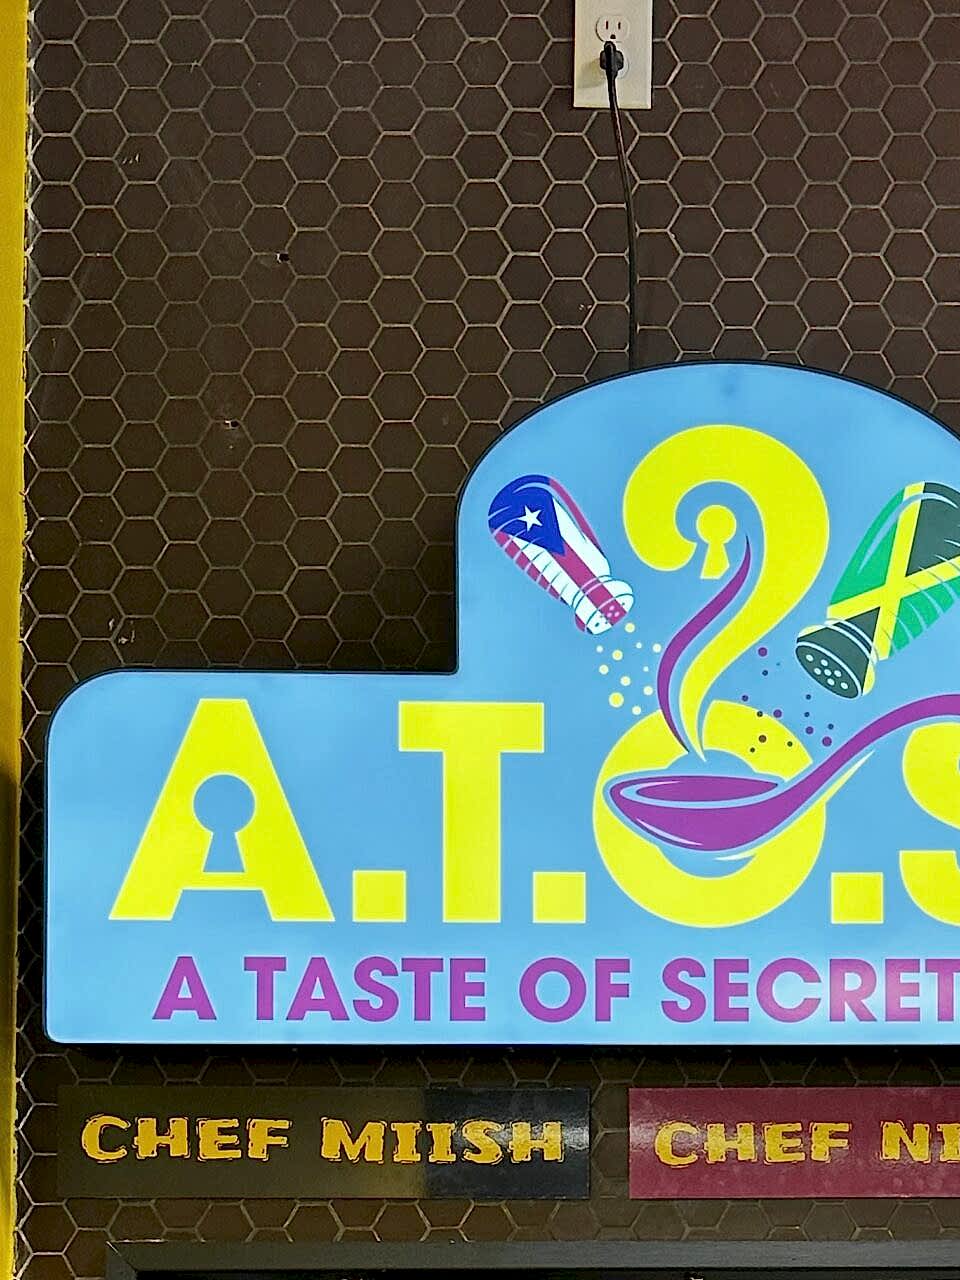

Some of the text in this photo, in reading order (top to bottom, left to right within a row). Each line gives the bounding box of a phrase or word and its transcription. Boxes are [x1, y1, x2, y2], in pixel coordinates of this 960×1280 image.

[153, 954, 215, 1021] A
[243, 955, 485, 1022] TASTE
[518, 955, 630, 1022] OF
[81, 1114, 565, 1165] CHEF MIISH
[653, 1119, 851, 1167] CHEF
